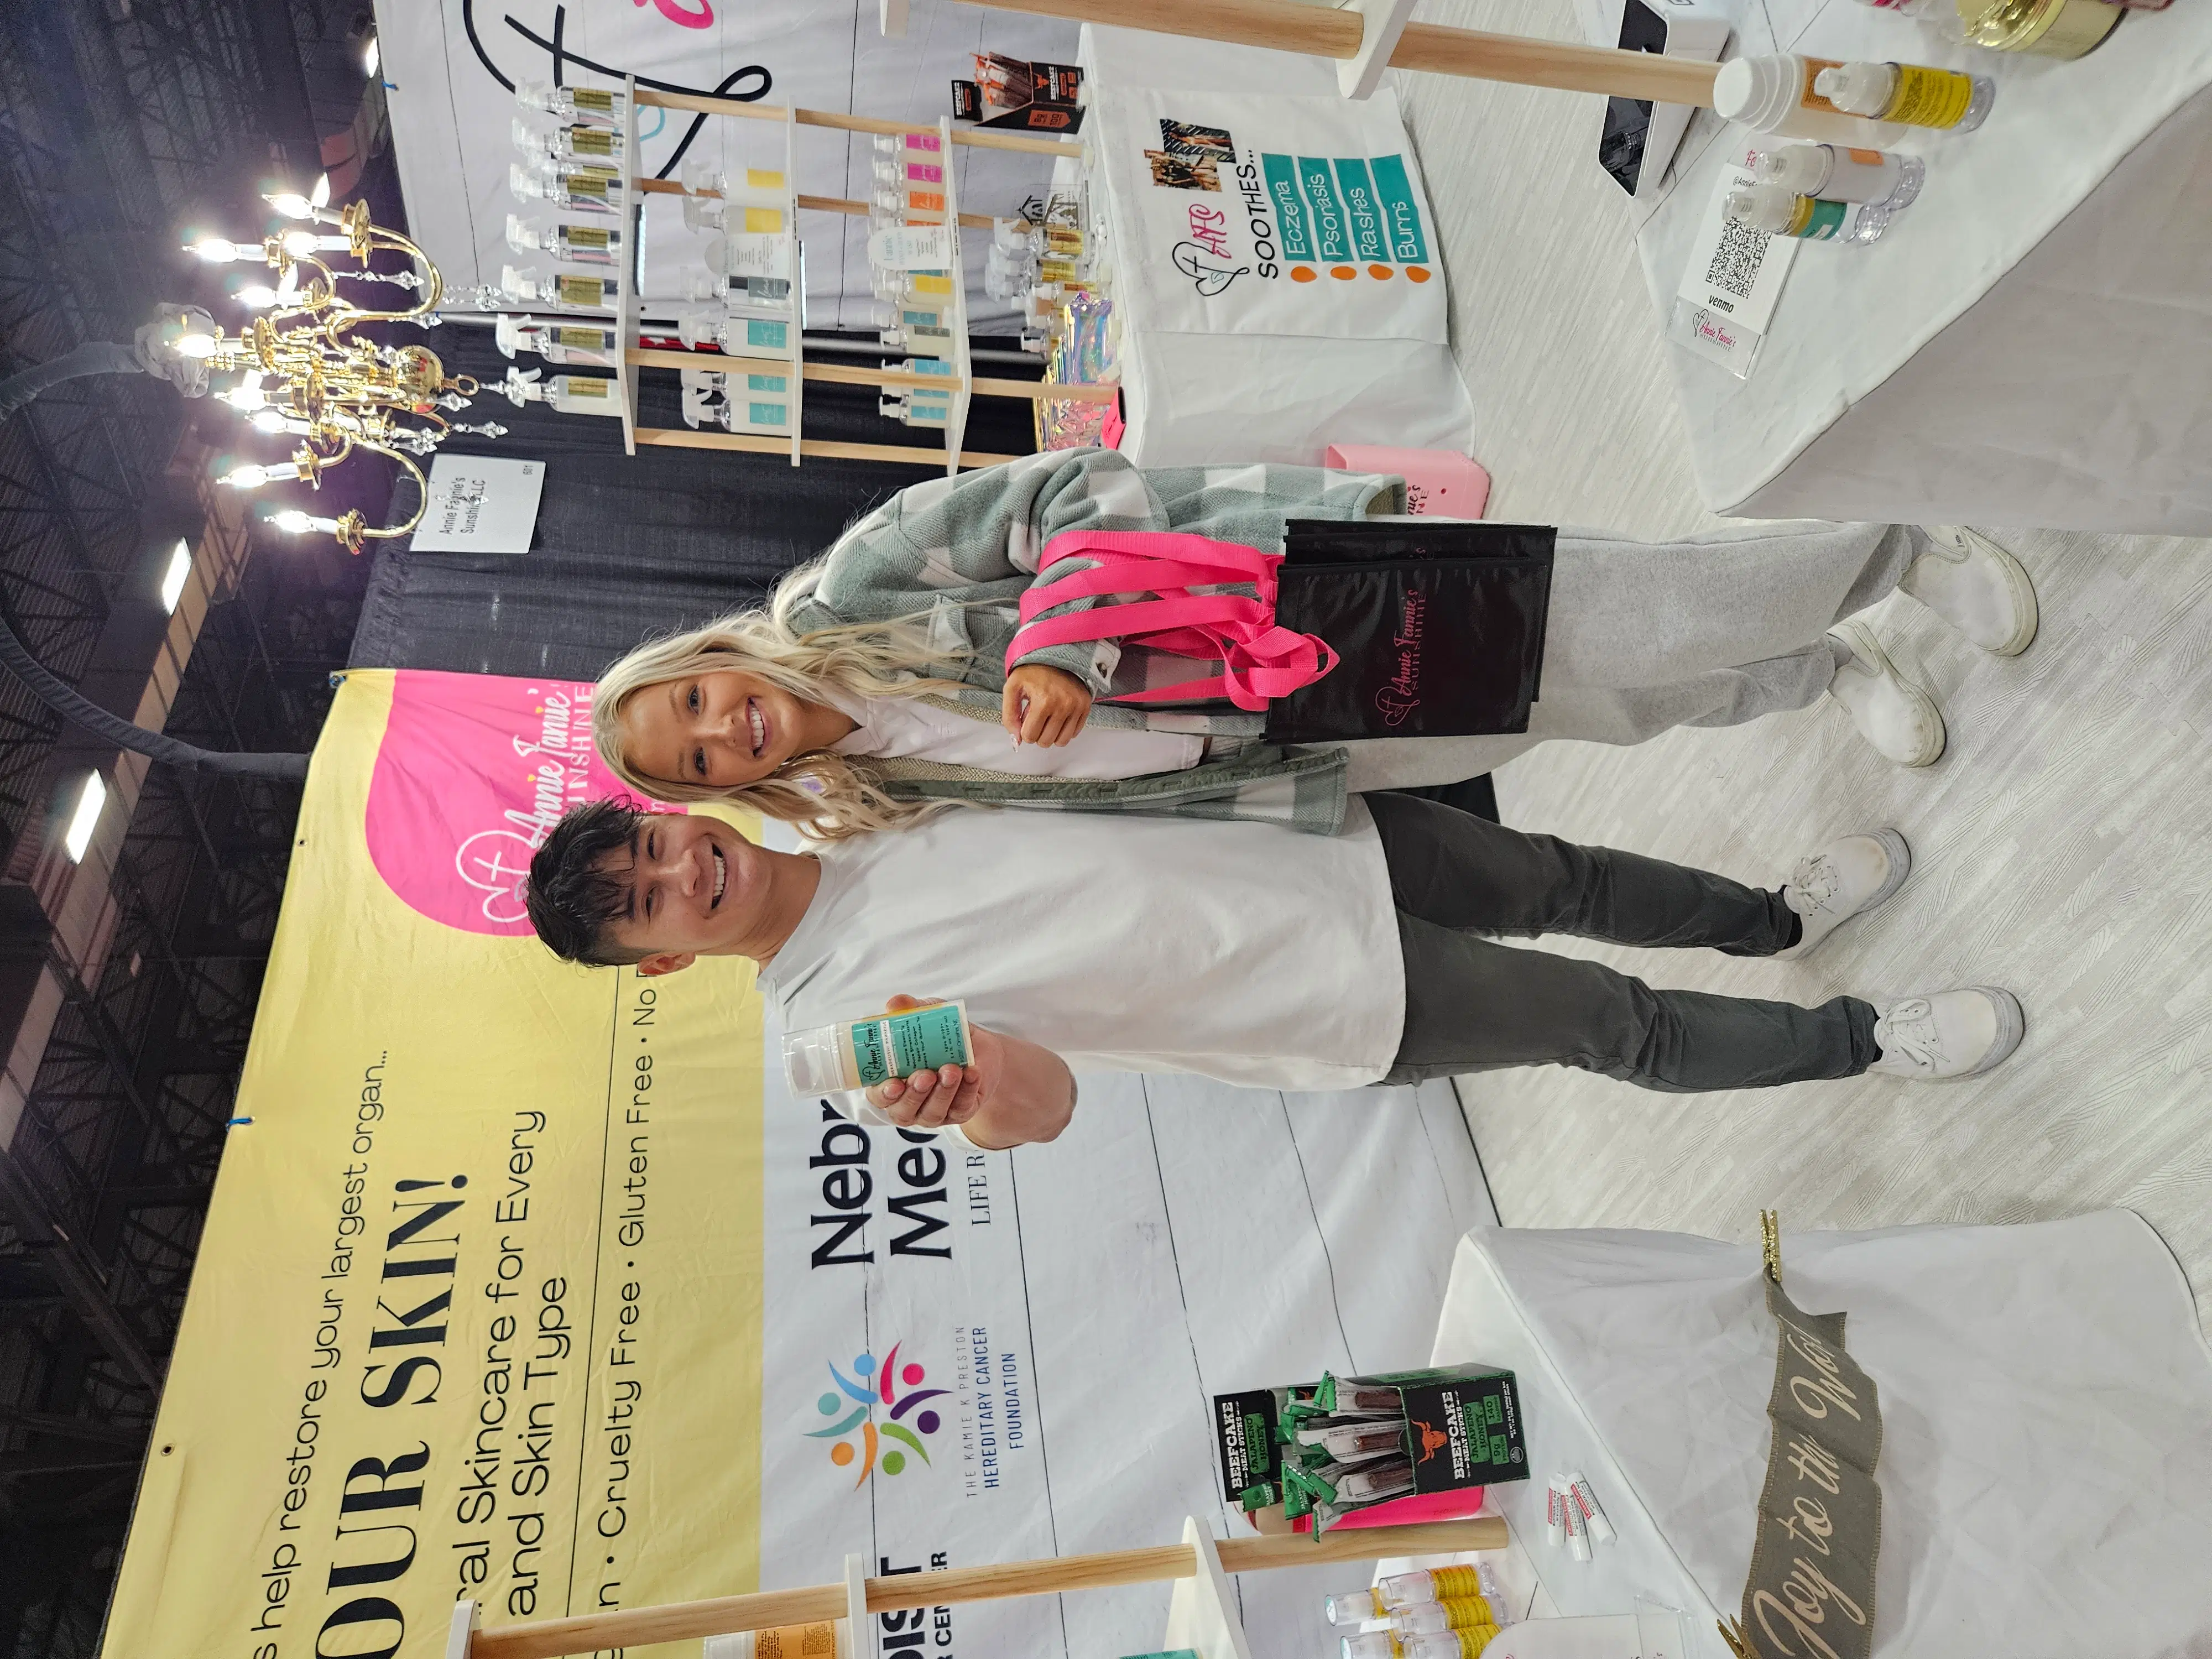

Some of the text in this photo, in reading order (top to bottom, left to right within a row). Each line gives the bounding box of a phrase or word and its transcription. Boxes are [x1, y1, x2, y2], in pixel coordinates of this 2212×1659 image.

[1236, 149, 1279, 279] SOOTHES...
[1275, 180, 1307, 254] Eczema
[1308, 174, 1344, 256] Psoriasis
[1350, 187, 1381, 256] Rashes
[1392, 201, 1419, 258] Burns
[1699, 321, 1716, 337] Annie
[1708, 295, 1734, 313] venmo
[439, 512, 457, 535] Annie
[460, 495, 480, 534] Sunshi
[1391, 589, 1418, 696] Annie Fannie's
[1410, 593, 1427, 690] SUNSHINE
[504, 759, 565, 848] Annie
[633, 989, 657, 1026] No
[627, 1055, 653, 1124] Free
[868, 1048, 880, 1070] Annie
[352, 1051, 388, 1154] organ...
[495, 1111, 546, 1223] Every
[618, 1136, 649, 1246] Gluten
[809, 1099, 875, 1270] Nebr
[968, 1175, 992, 1227] LIFE
[321, 1163, 368, 1279] largest
[361, 1174, 468, 1407] SKIN!
[485, 1236, 524, 1303] for
[311, 1289, 343, 1369] your
[610, 1281, 641, 1366] Free
[955, 1327, 969, 1389] PRESTON
[457, 1314, 517, 1524] Skincare
[972, 1327, 1000, 1488] HEREDITARY CANCER
[1001, 1353, 1024, 1449] FOUNDATION
[1442, 1391, 1465, 1479] BEEFCAKE
[1457, 1406, 1470, 1461] MEAT STICKS
[1465, 1406, 1479, 1458] JALAPENO
[1475, 1413, 1487, 1449] HONEY
[1486, 1401, 1495, 1419] 140
[279, 1380, 327, 1531] restore
[508, 1277, 572, 1616] and Skin Type
[598, 1381, 641, 1537] Cruelty
[961, 1416, 974, 1460] KAMIE
[1222, 1401, 1243, 1489] BEEFCAKE
[1235, 1416, 1249, 1471] MEAT STICKS
[1246, 1417, 1259, 1471] JALAPENO
[1256, 1425, 1267, 1460] HONEY
[1493, 1443, 1501, 1457] 9g
[965, 1470, 978, 1498] THE
[1261, 1483, 1271, 1506] ALAPENO
[1775, 1496, 1833, 1556] to
[251, 1543, 301, 1631] help
[1752, 1557, 1867, 1659] Joy
